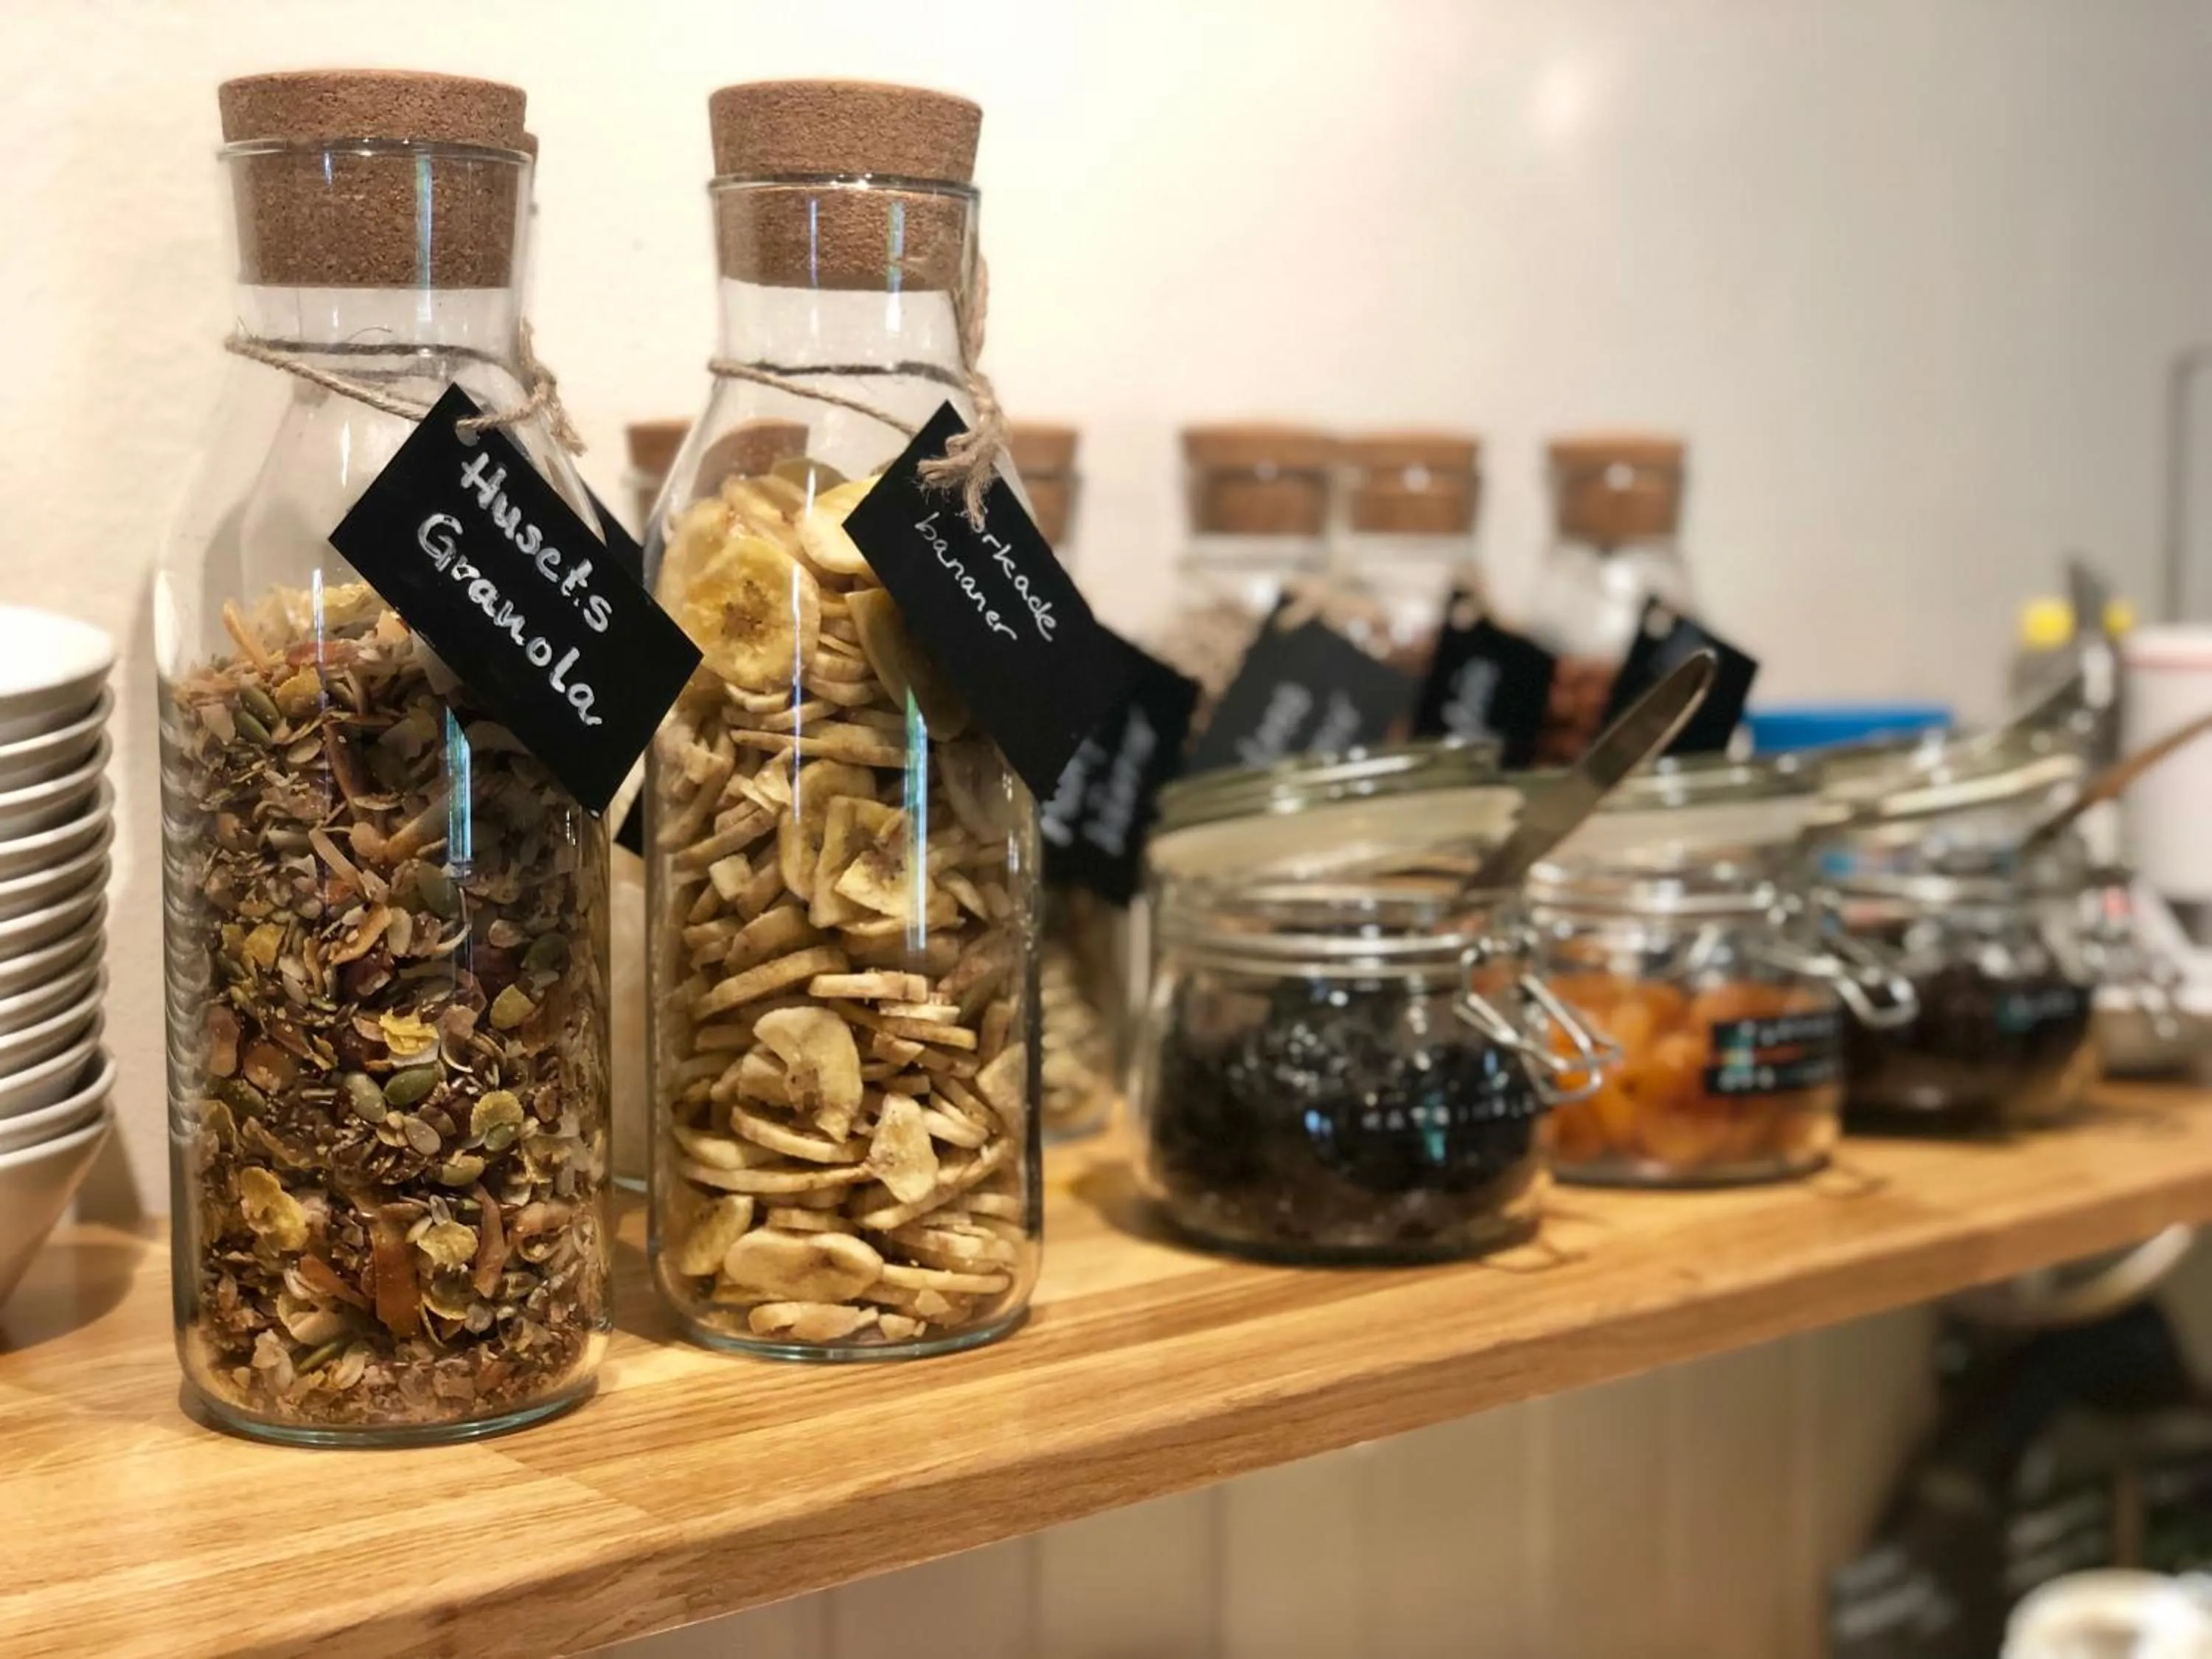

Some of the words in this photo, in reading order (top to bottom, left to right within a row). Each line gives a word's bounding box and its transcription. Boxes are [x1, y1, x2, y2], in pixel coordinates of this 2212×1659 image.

[418, 513, 602, 725] Granola
[461, 452, 612, 632] Husets
[915, 512, 1018, 640] bananer
[957, 505, 1056, 641] rkade
